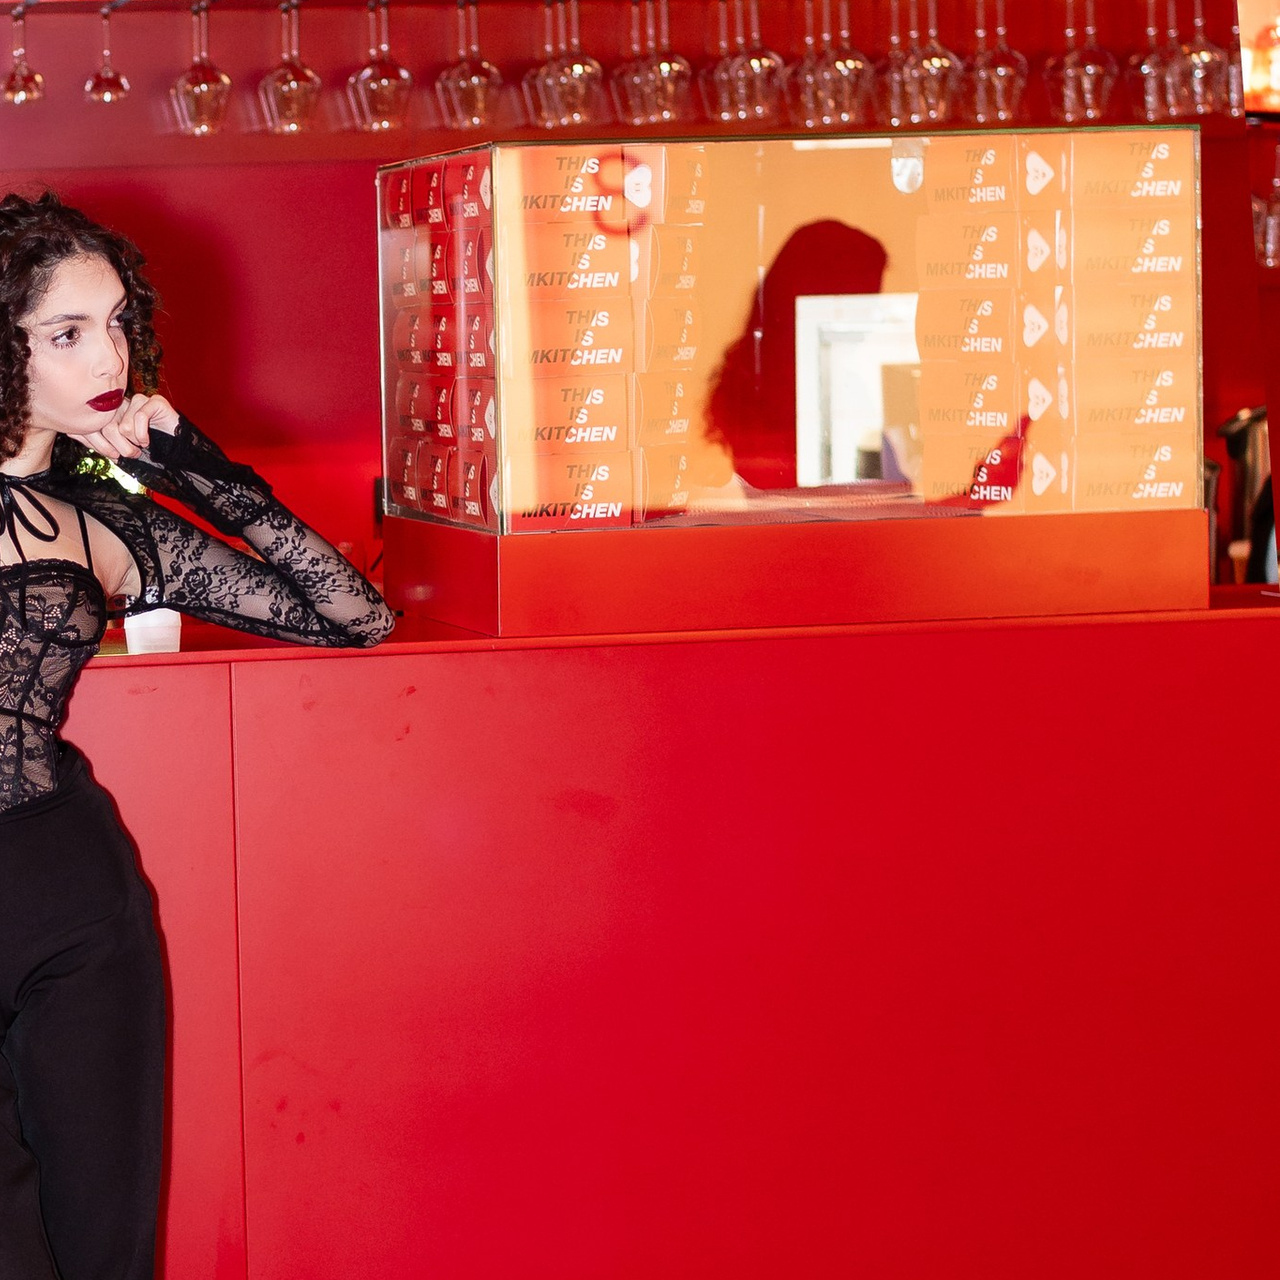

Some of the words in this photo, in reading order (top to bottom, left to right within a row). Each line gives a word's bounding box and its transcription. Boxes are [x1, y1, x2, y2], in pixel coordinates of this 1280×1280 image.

[556, 156, 600, 173] THIS
[565, 175, 583, 193] IS
[563, 233, 606, 250] THIS
[571, 252, 590, 269] IS
[566, 310, 609, 327] THIS
[575, 328, 594, 346] IS
[561, 387, 604, 405] THIS
[569, 406, 588, 424] IS
[566, 463, 609, 481] THIS
[973, 465, 987, 482] IS
[575, 482, 593, 500] IS
[522, 502, 622, 519] MKITCHEN
